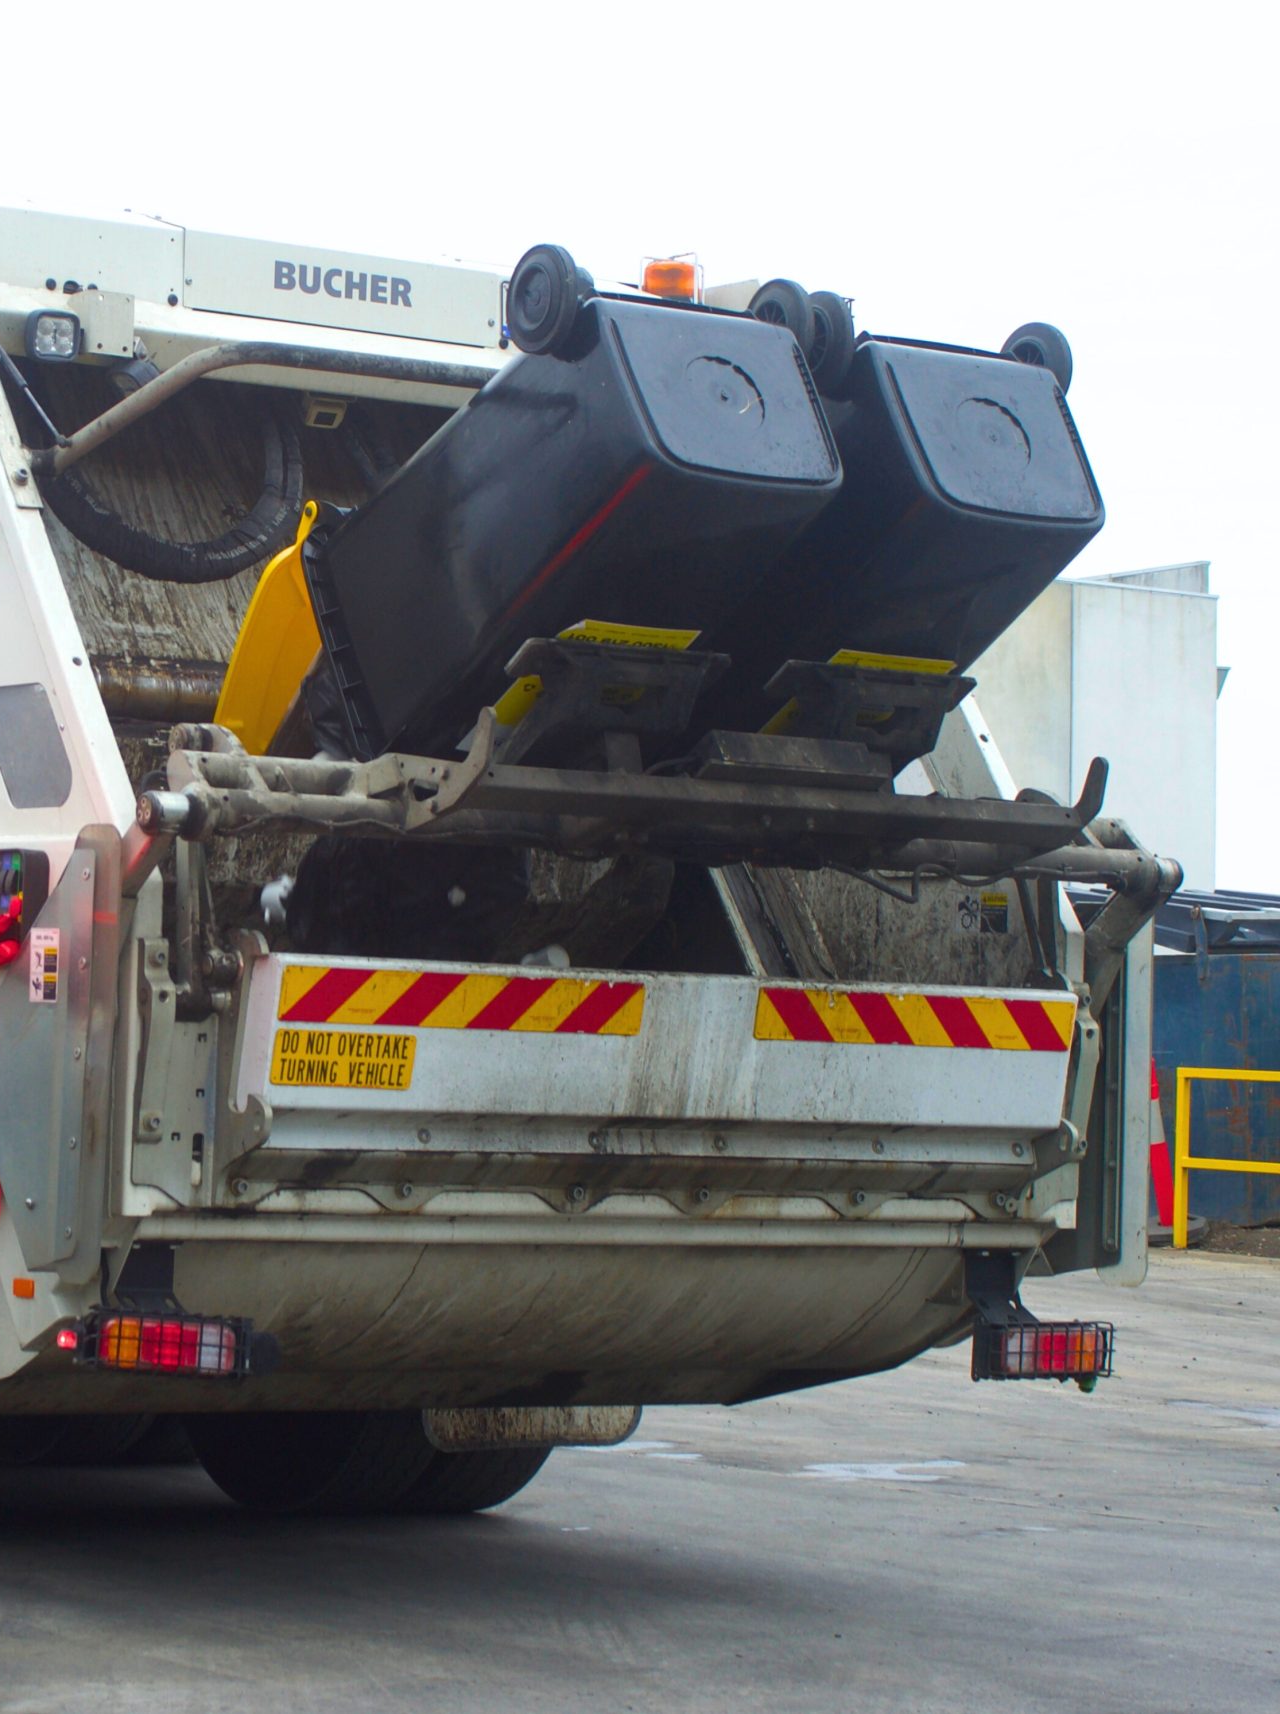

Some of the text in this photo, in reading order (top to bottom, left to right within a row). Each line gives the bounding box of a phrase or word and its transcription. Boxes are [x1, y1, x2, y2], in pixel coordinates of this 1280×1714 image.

[273, 260, 412, 307] BUCHER
[281, 1031, 410, 1060] DO NOT OVERTAKE
[279, 1058, 406, 1087] TURNING VEHICLE
